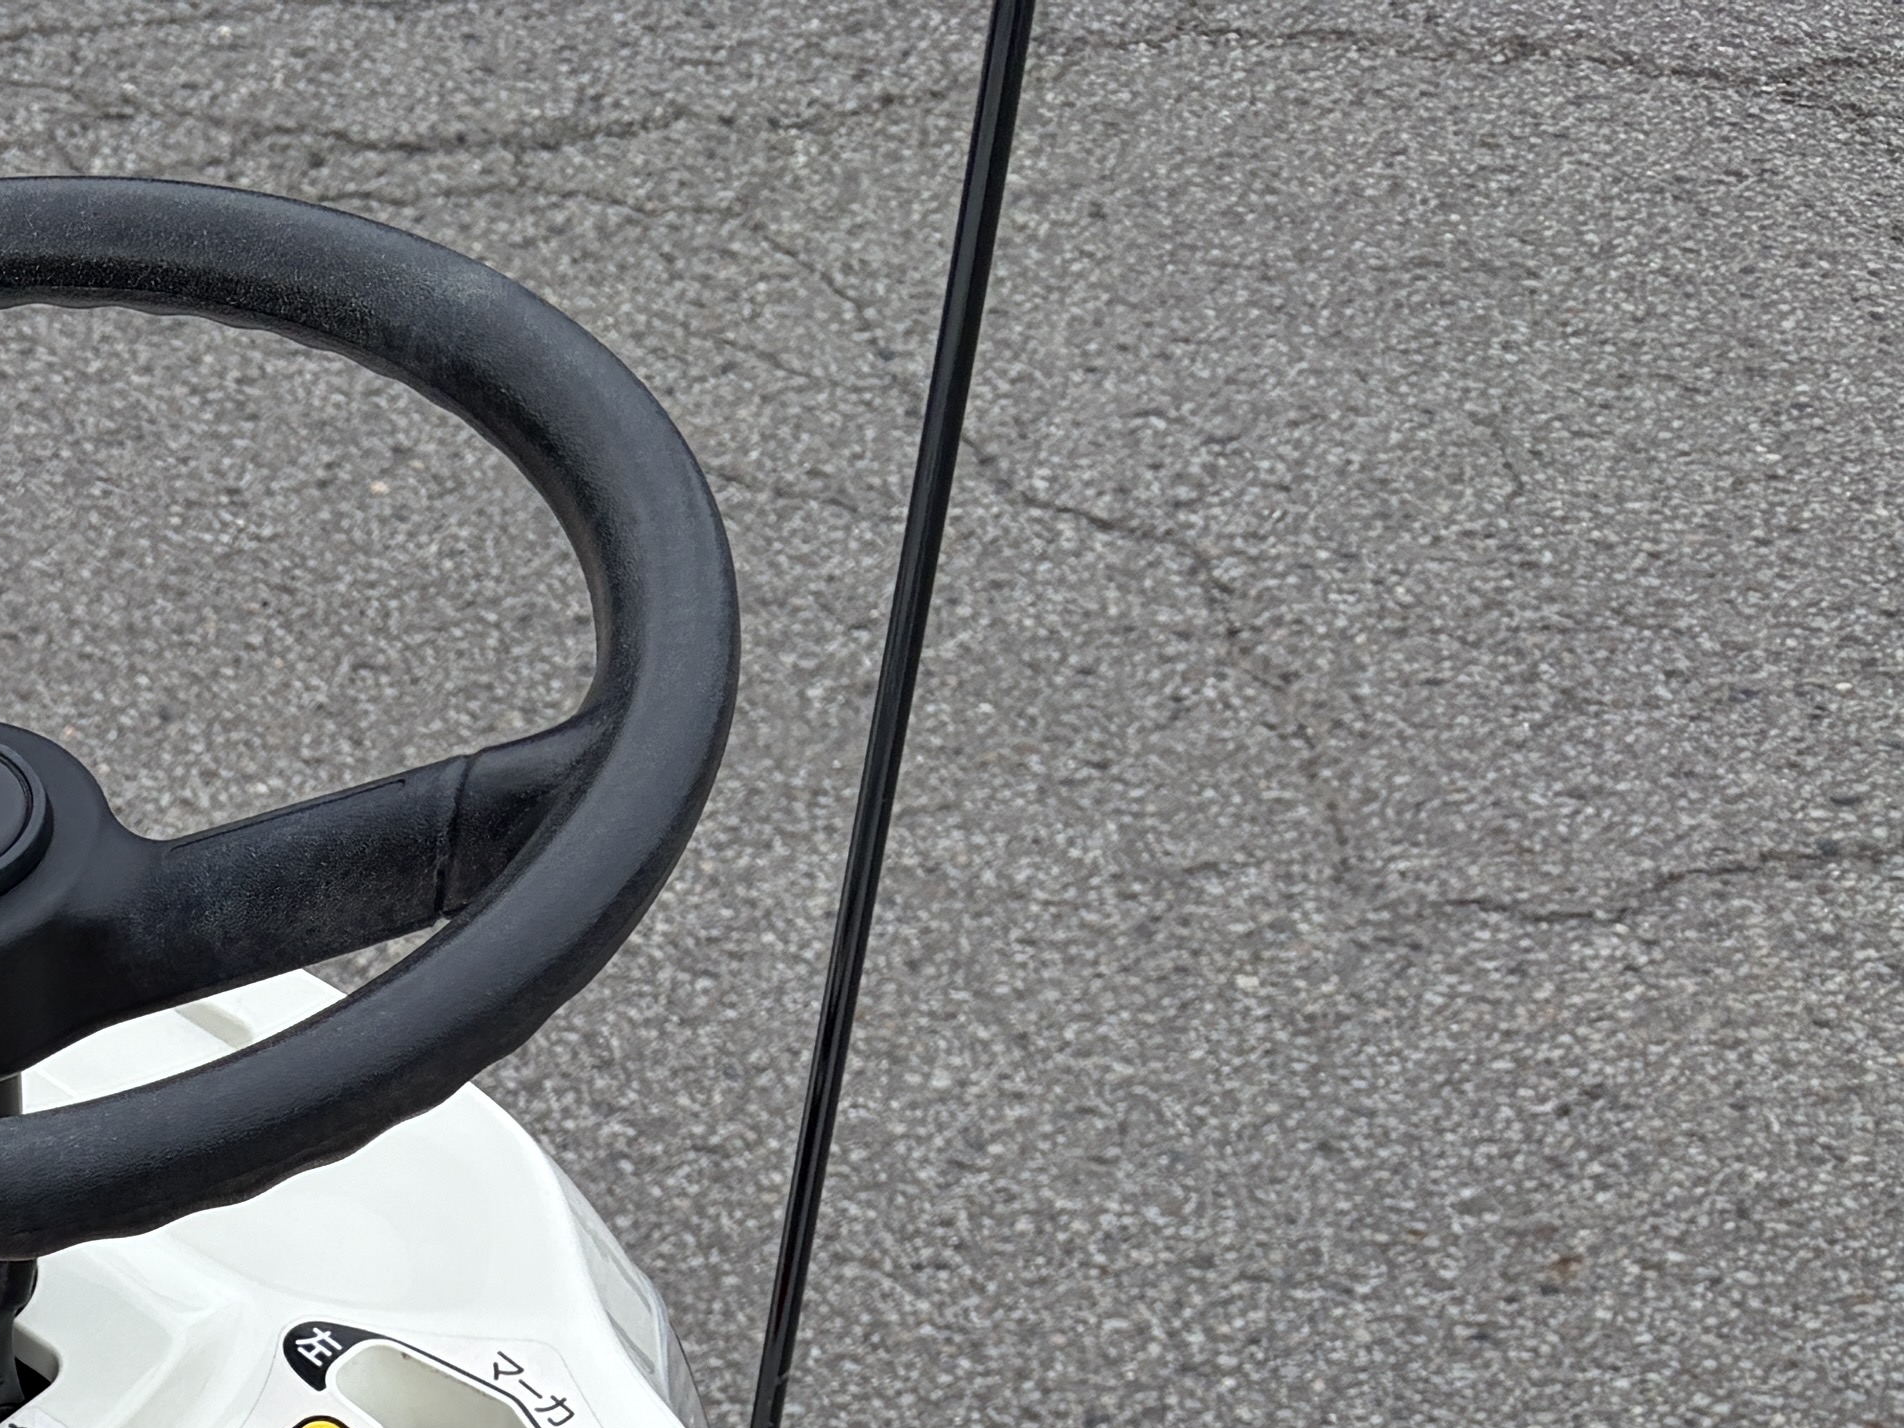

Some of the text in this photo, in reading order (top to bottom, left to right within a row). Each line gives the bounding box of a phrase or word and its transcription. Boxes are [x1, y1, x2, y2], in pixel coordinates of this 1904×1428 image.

[295, 1327, 343, 1367] 左
[491, 1351, 577, 1427] マーカ
